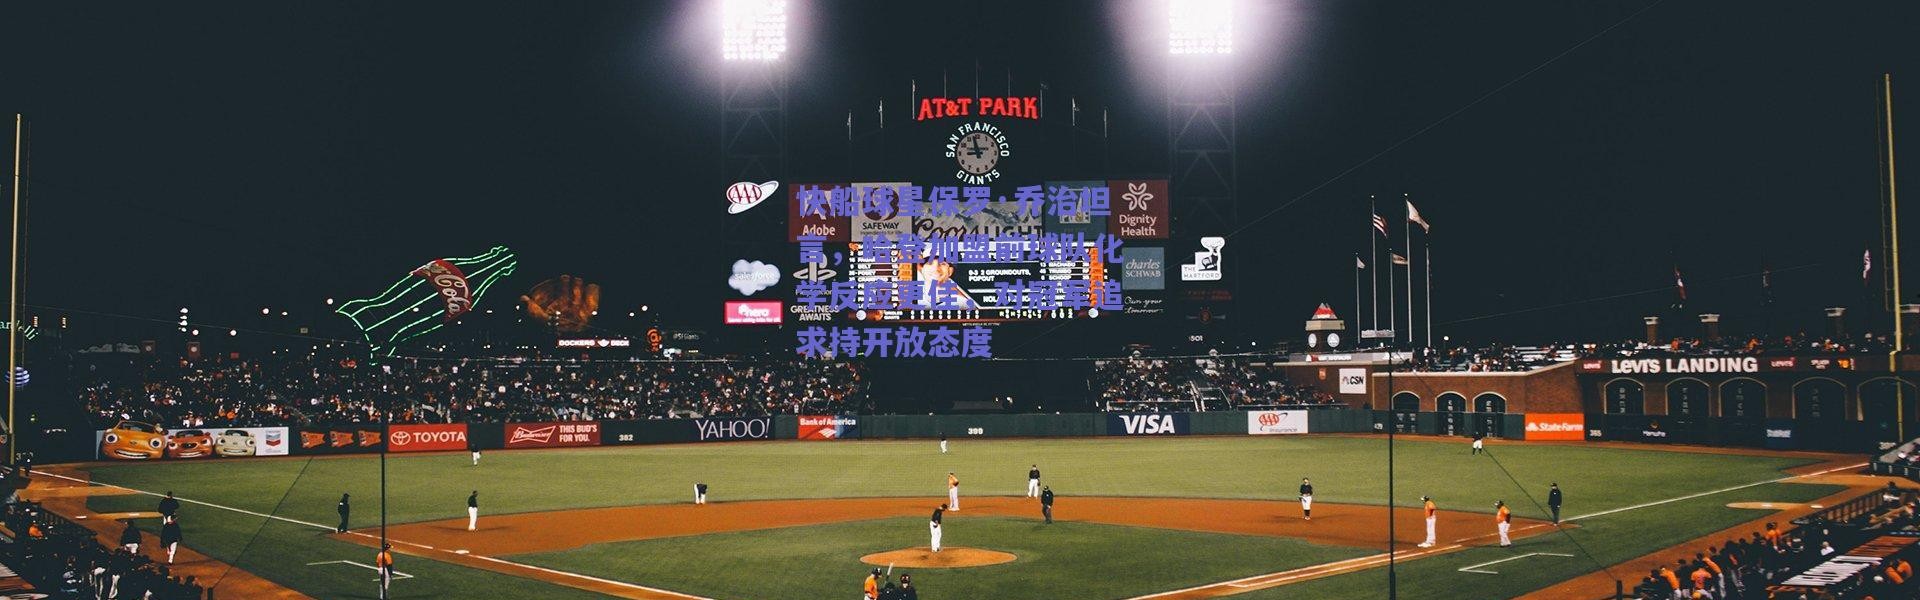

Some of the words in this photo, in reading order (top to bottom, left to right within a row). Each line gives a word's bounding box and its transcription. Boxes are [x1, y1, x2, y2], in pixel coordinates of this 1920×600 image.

[918, 97, 972, 120] AT&T
[979, 97, 1038, 119] PARK
[946, 134, 960, 158] SAN
[958, 121, 1010, 157] FRANCISCO
[956, 169, 1000, 185] GIANTS
[730, 184, 761, 204] AAA
[862, 222, 900, 230] SAFEWAY
[1119, 215, 1157, 227] Dignity
[802, 224, 836, 236] Adobe
[1121, 227, 1156, 236] Health
[1126, 259, 1160, 269] charles
[1126, 270, 1161, 278] SCHWAB
[434, 274, 470, 315] Cola
[799, 313, 832, 321] AWAITS
[1666, 357, 1758, 373] LANDING
[1349, 376, 1364, 385] CSN
[800, 418, 818, 426] Bank
[818, 418, 826, 426] of
[826, 418, 856, 426] America
[1119, 414, 1175, 434] VISA
[559, 425, 576, 433] THIS
[576, 424, 598, 433] BUD'S
[696, 419, 770, 440] YAHOO!
[413, 431, 466, 442] TOYOTA
[514, 430, 552, 439] Budweiser
[559, 434, 574, 442] FOR
[575, 434, 590, 442] YOU.
